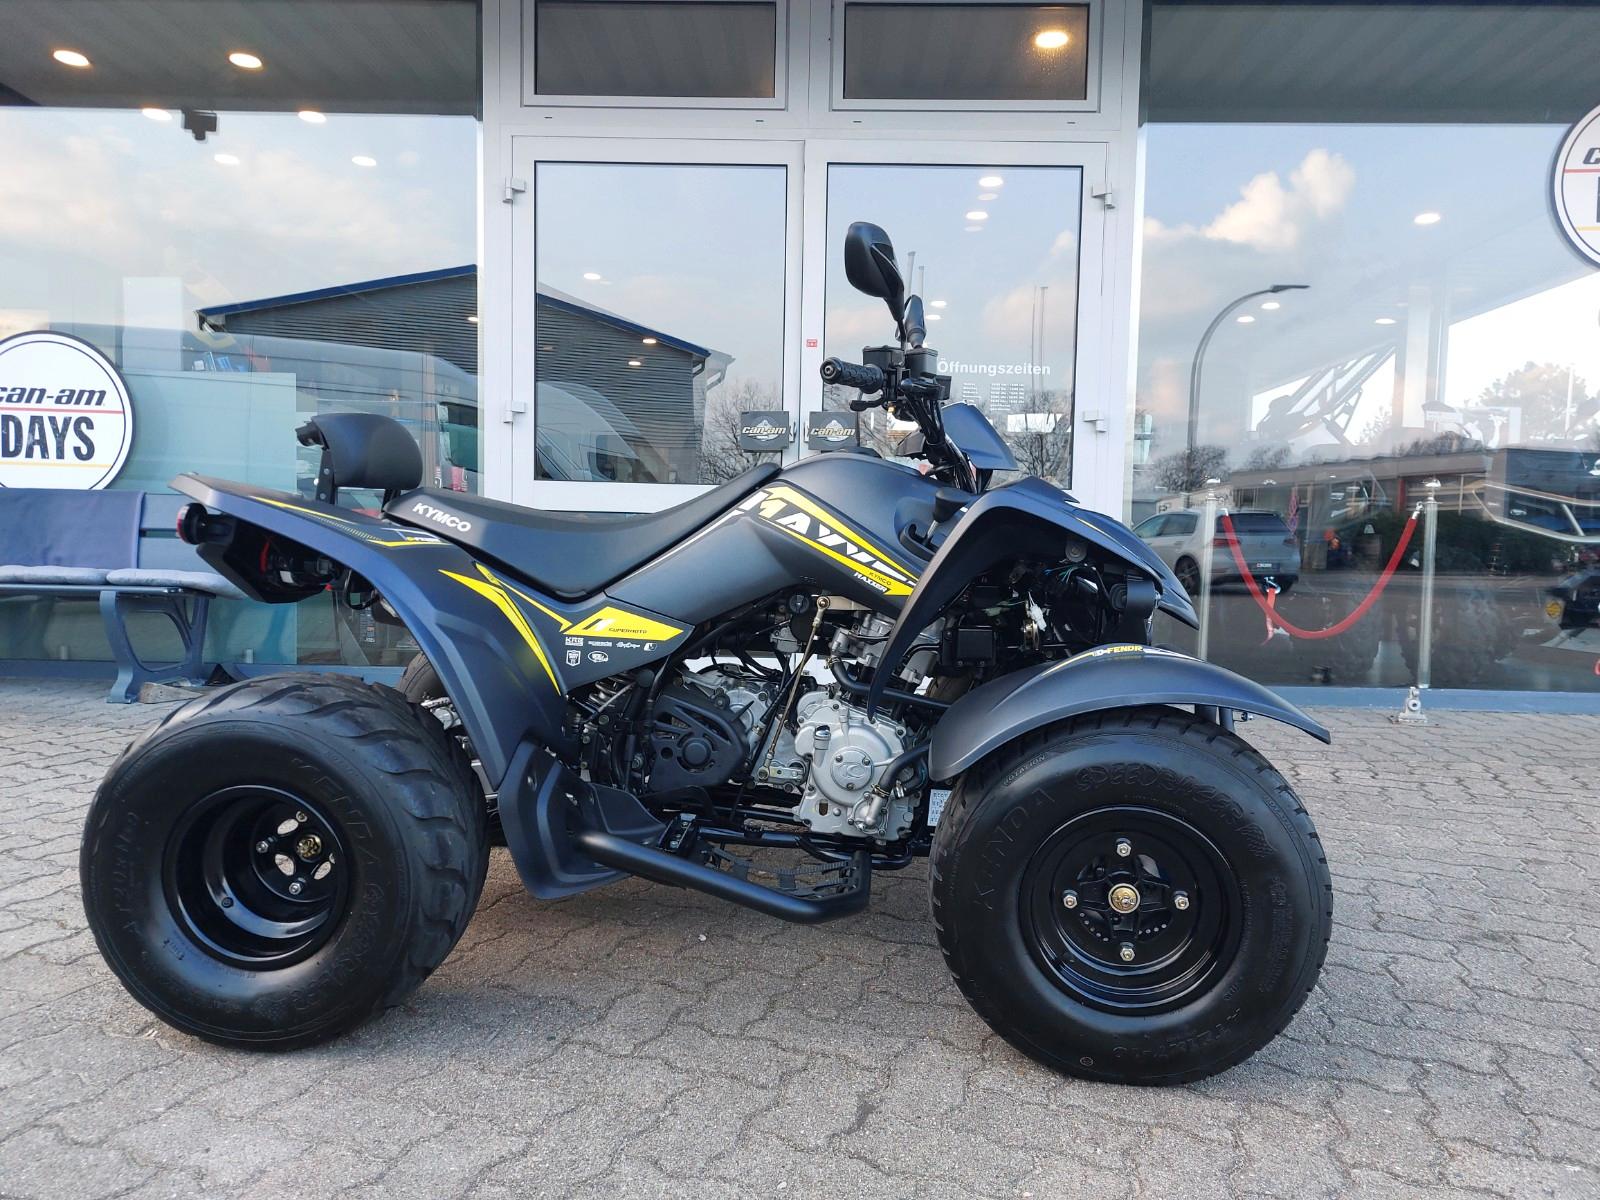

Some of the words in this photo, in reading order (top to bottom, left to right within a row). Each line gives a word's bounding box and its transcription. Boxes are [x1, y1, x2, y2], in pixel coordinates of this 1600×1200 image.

[937, 357, 1051, 377] Öffnungszeiten
[1, 414, 95, 461] DAYS
[742, 426, 786, 434] can-am
[810, 427, 856, 436] can-am
[412, 502, 472, 532] KYMCO
[869, 571, 892, 586] KYMCO
